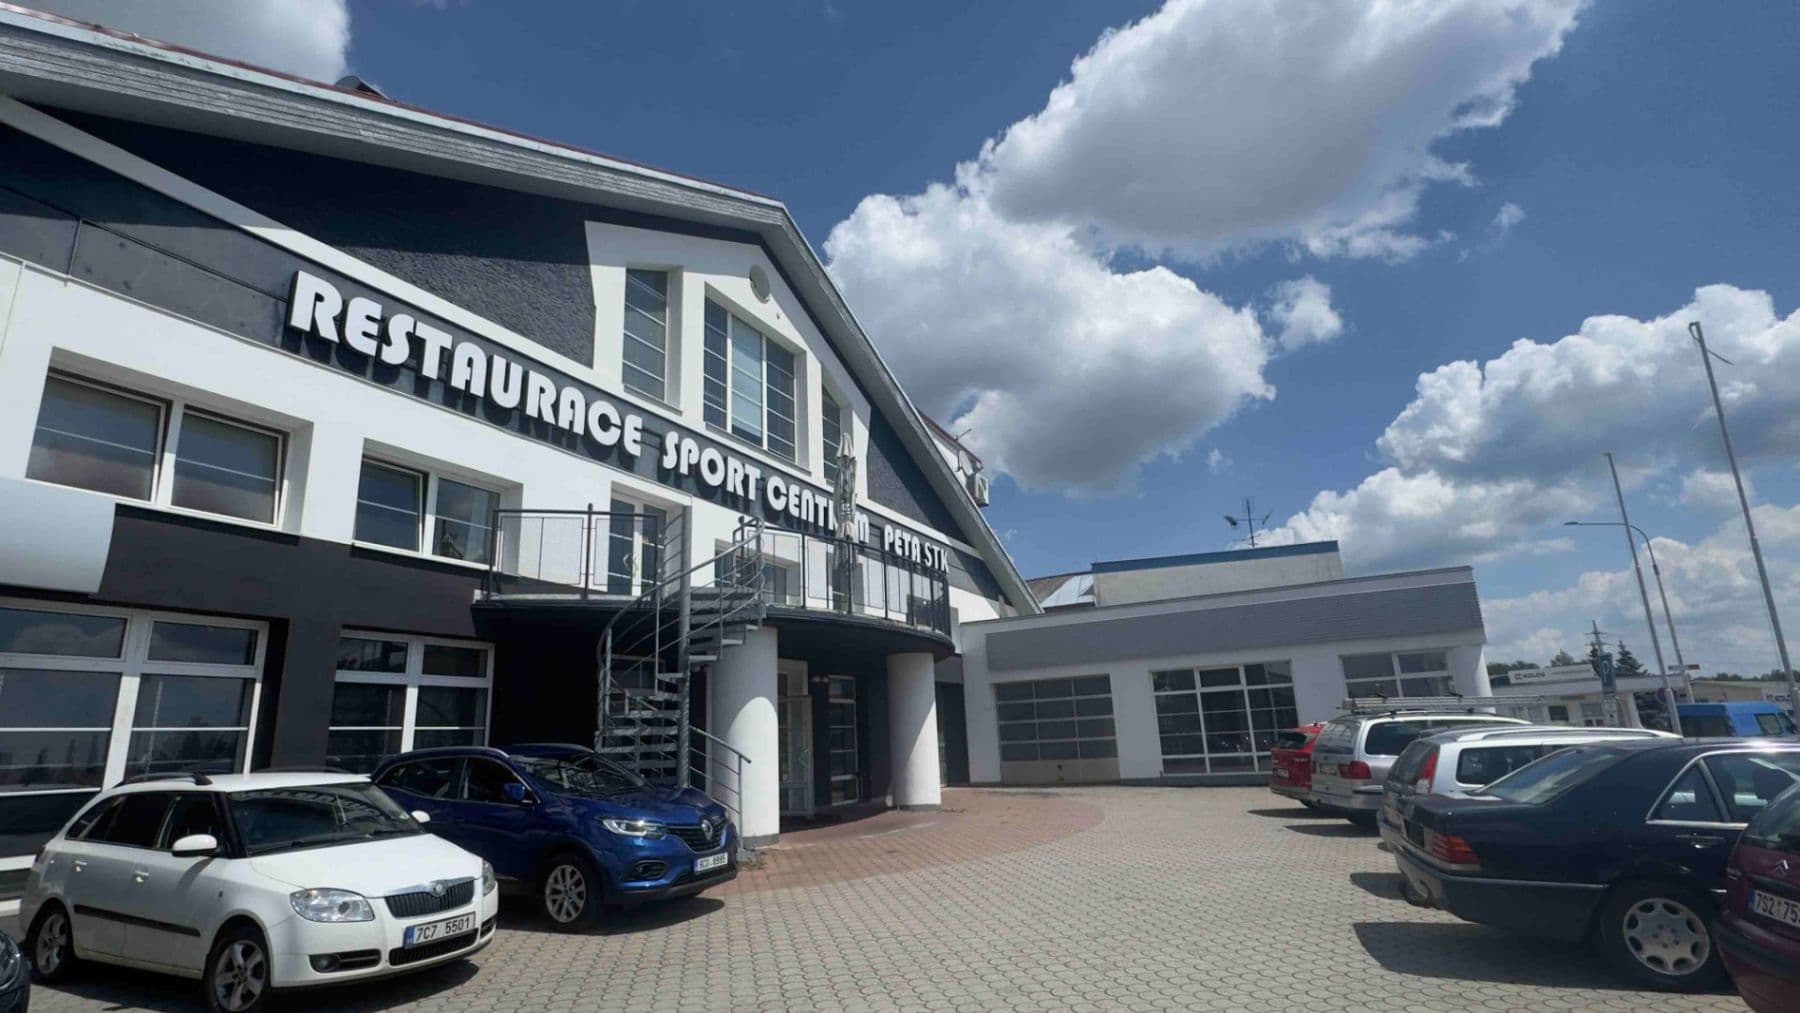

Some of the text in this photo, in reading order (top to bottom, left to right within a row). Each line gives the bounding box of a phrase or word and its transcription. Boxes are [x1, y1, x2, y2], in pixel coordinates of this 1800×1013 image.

[289, 270, 643, 457] RESTAURACE
[663, 431, 761, 501] SPORT
[766, 475, 870, 545] CENTM
[924, 541, 949, 574] STK
[1783, 900, 1800, 923] 75
[416, 917, 470, 941] 7C7 5501
